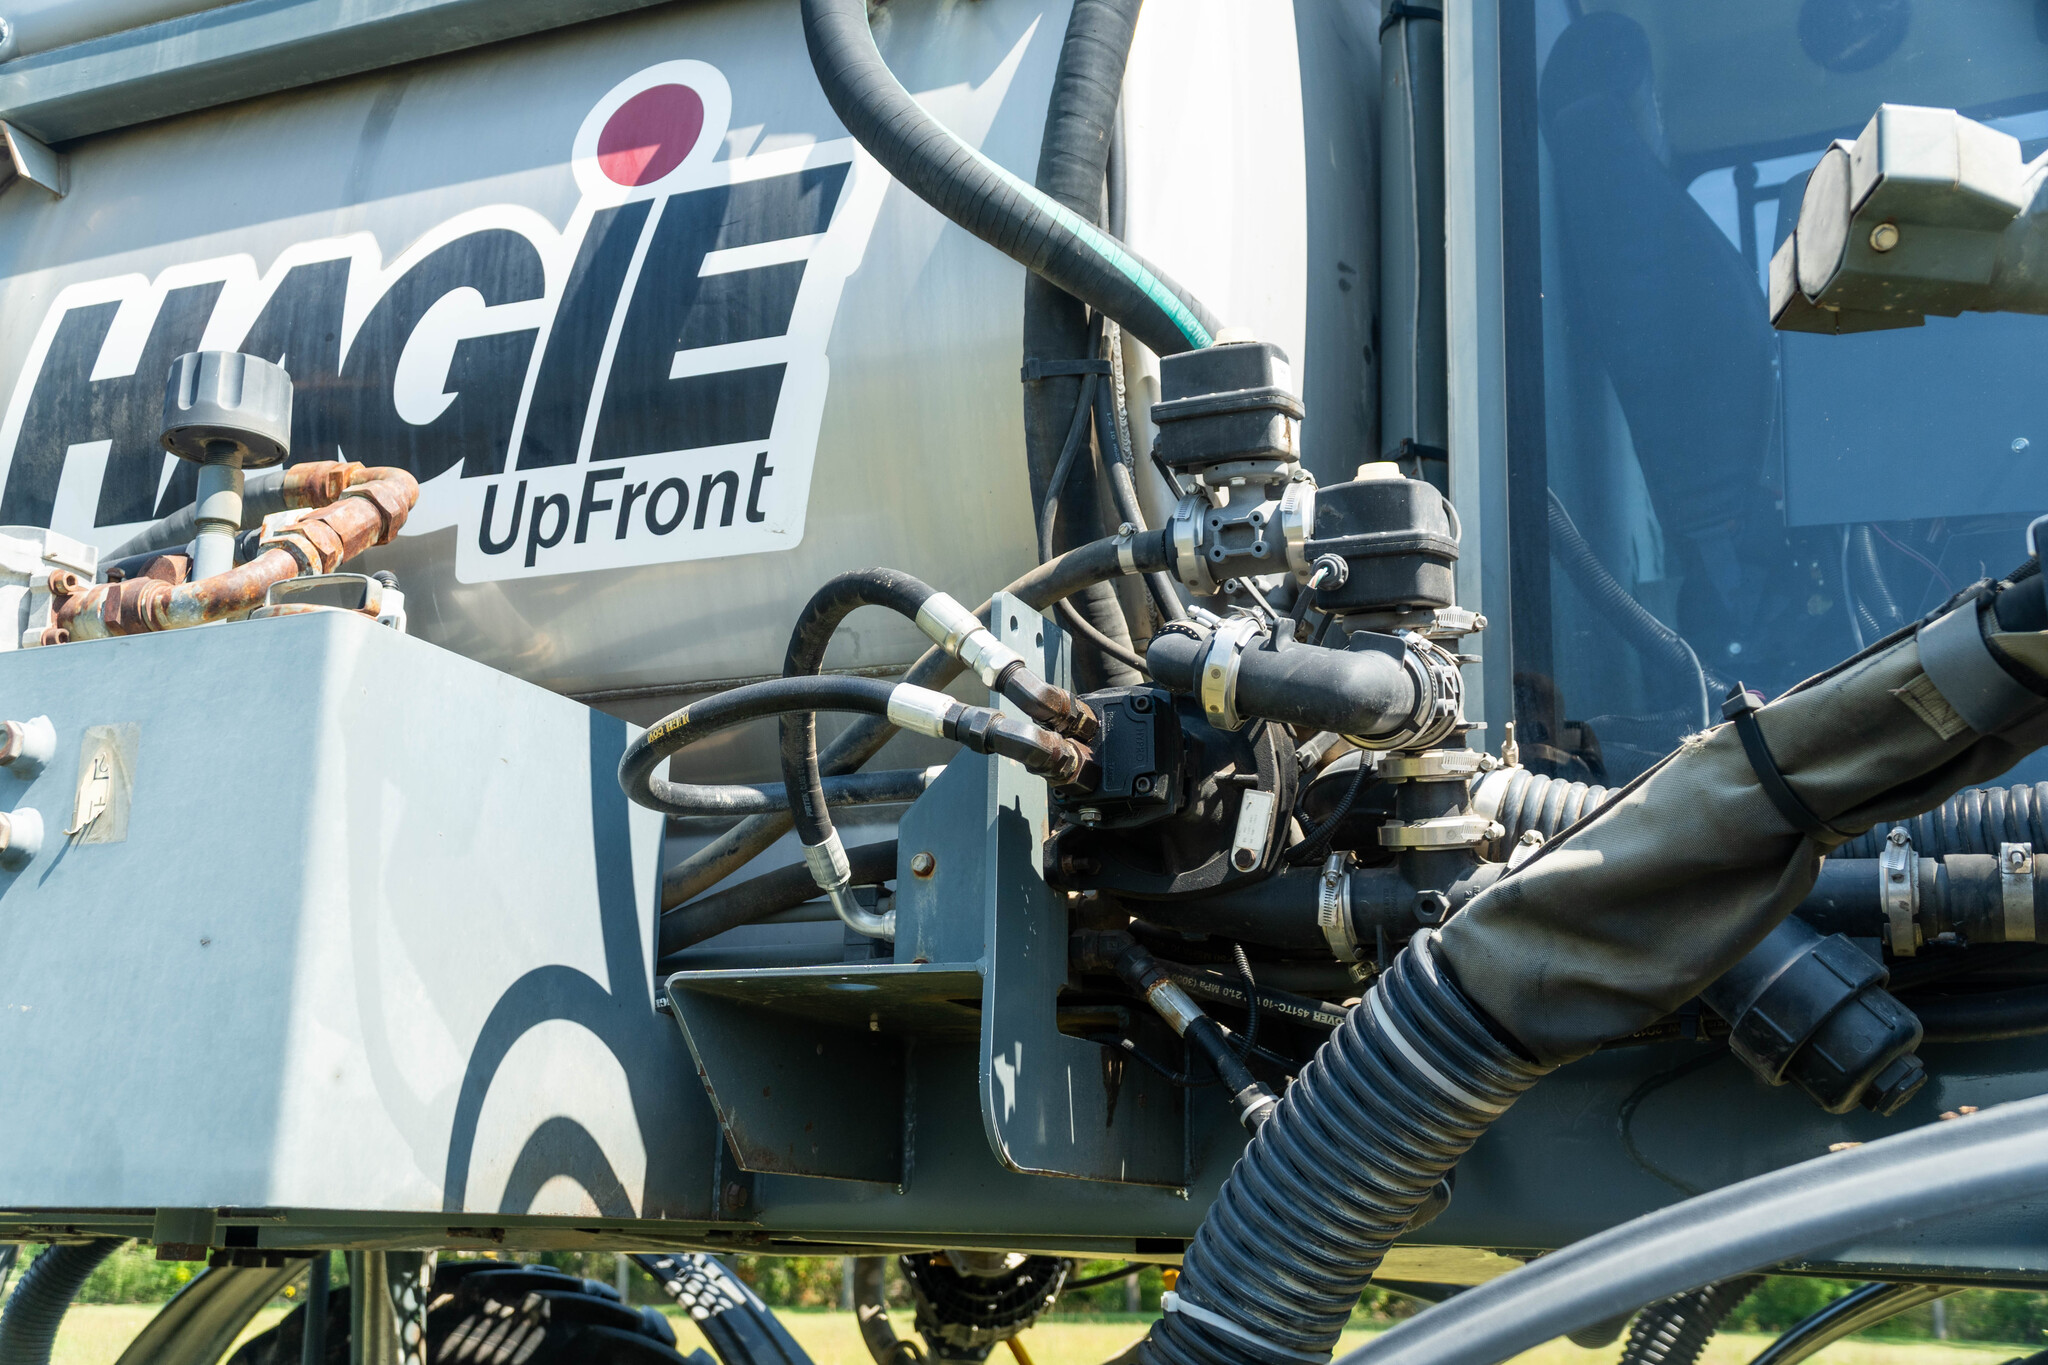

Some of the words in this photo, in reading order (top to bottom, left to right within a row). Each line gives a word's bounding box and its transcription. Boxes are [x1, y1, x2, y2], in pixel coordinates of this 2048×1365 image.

[478, 451, 774, 568] UpFront
[1135, 728, 1145, 762] HYPRO
[1199, 980, 1220, 994] MPa
[1262, 998, 1310, 1018] 451TC-10
